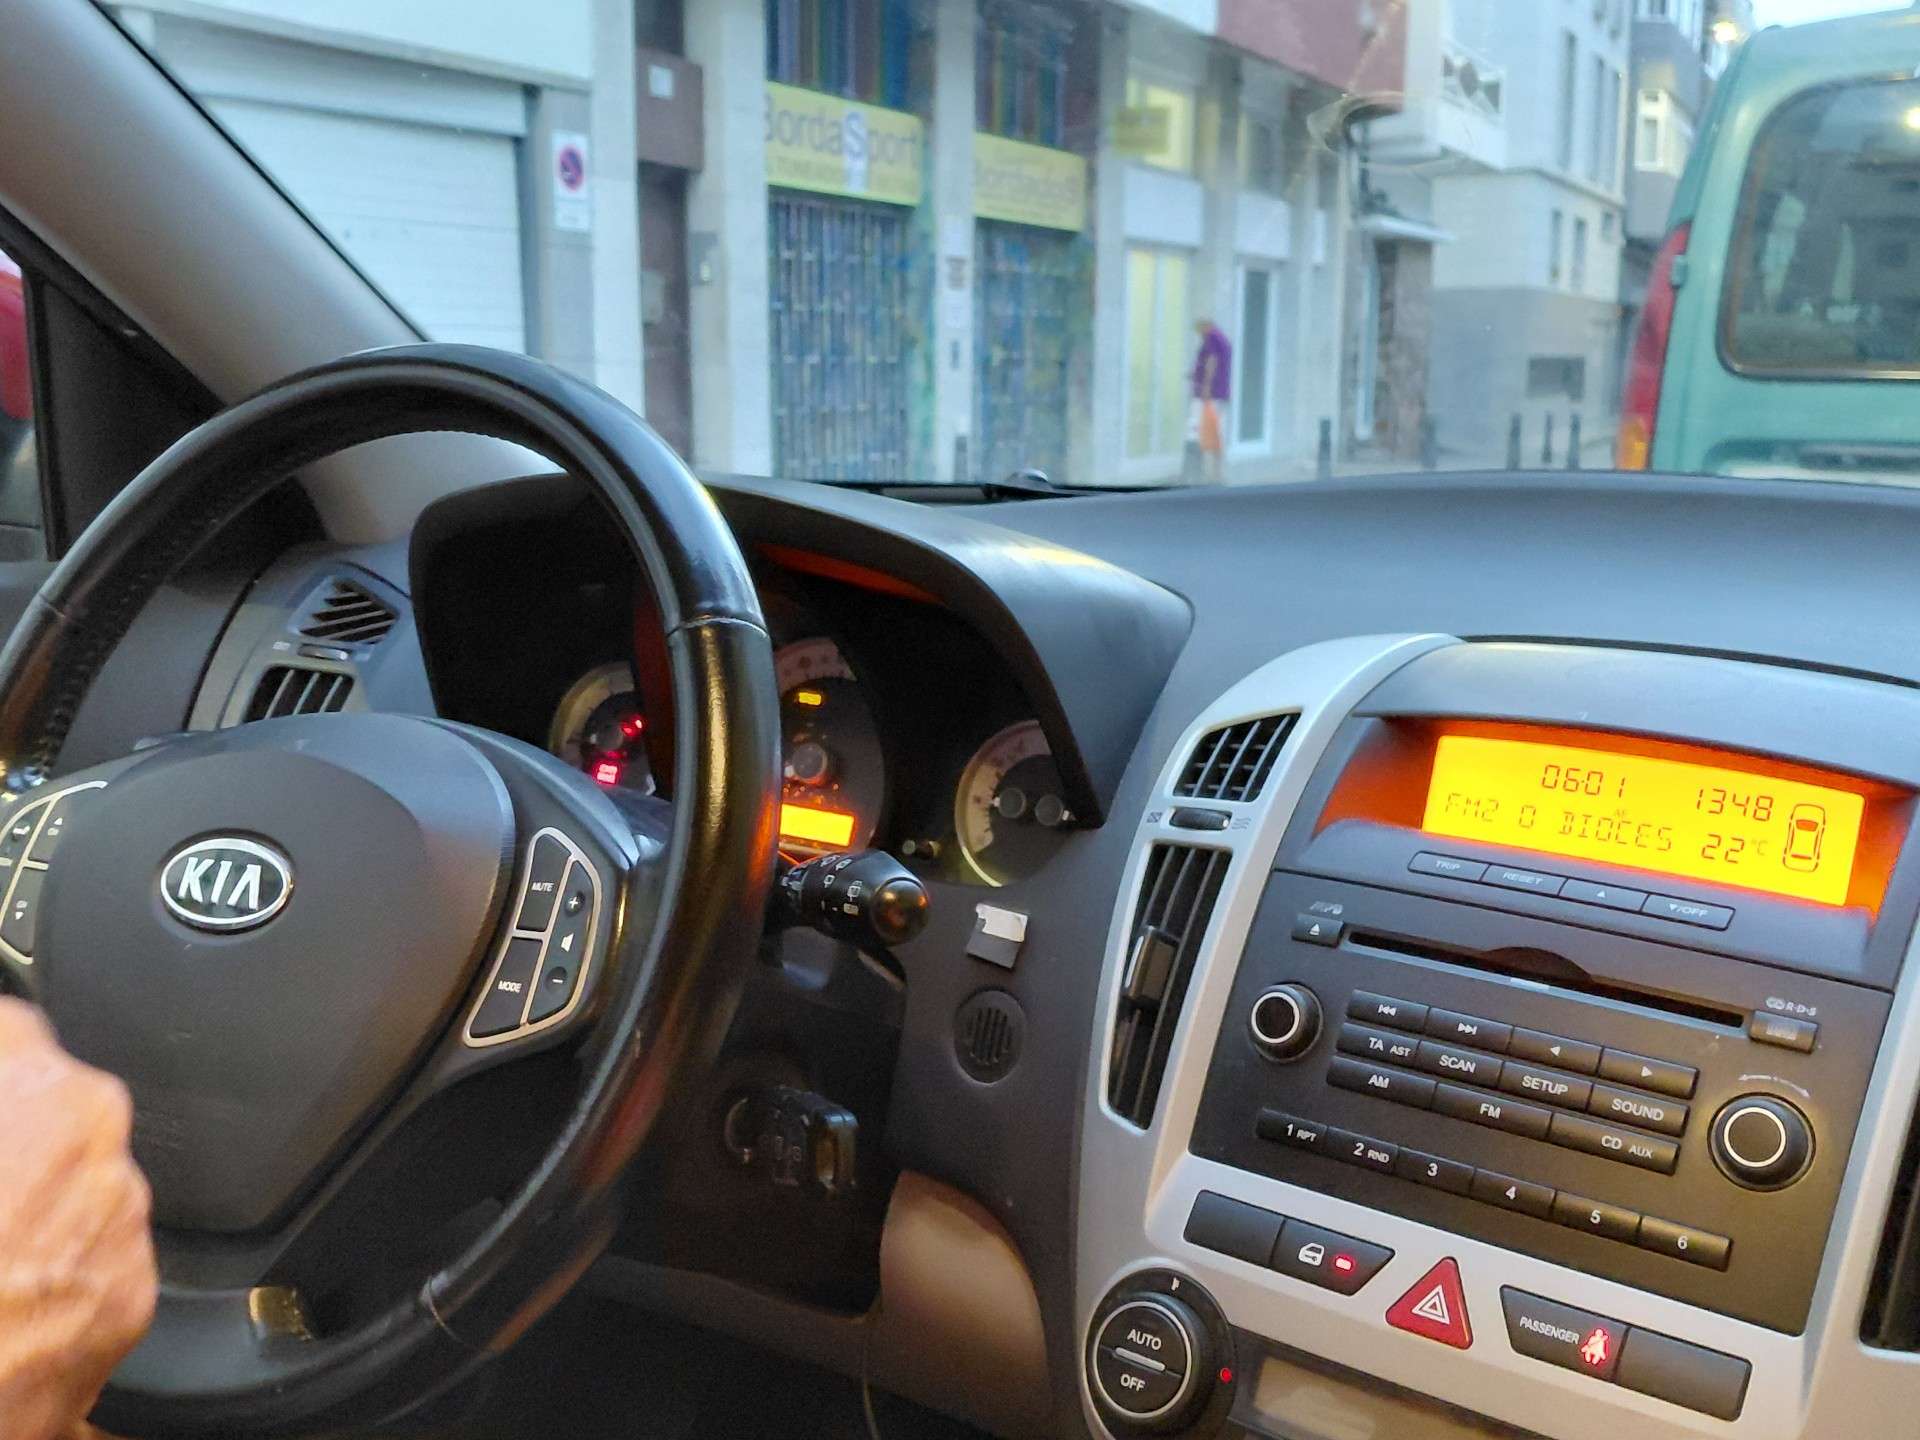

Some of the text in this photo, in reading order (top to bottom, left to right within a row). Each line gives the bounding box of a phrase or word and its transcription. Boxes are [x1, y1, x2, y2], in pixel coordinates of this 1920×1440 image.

[1696, 788, 1774, 822] 1348
[1445, 793, 1499, 822] FM2
[1558, 811, 1672, 851] DIOCES
[1435, 859, 1461, 871] TRIP
[178, 856, 262, 911] KIA
[531, 882, 554, 892] MUTE
[1502, 871, 1542, 886] RESET
[497, 980, 522, 993] MODE
[1368, 1037, 1411, 1057] TA AST
[1439, 1054, 1476, 1073] SCAN
[1368, 1074, 1390, 1089] AM
[1521, 1075, 1569, 1096] SETUP
[1479, 1102, 1501, 1119] FM
[1611, 1098, 1664, 1121] SOUND
[1286, 1123, 1317, 1142] 1 RPT
[1353, 1142, 1390, 1164] 2 RND
[1601, 1135, 1653, 1159] CD AUX
[1427, 1162, 1439, 1177] 3
[1505, 1186, 1516, 1200] 4
[1589, 1209, 1601, 1224] 5
[1677, 1235, 1688, 1250] 6
[1126, 1328, 1162, 1350] AUTO
[1519, 1316, 1580, 1344] PASSENGER
[1120, 1373, 1146, 1392] OFF
